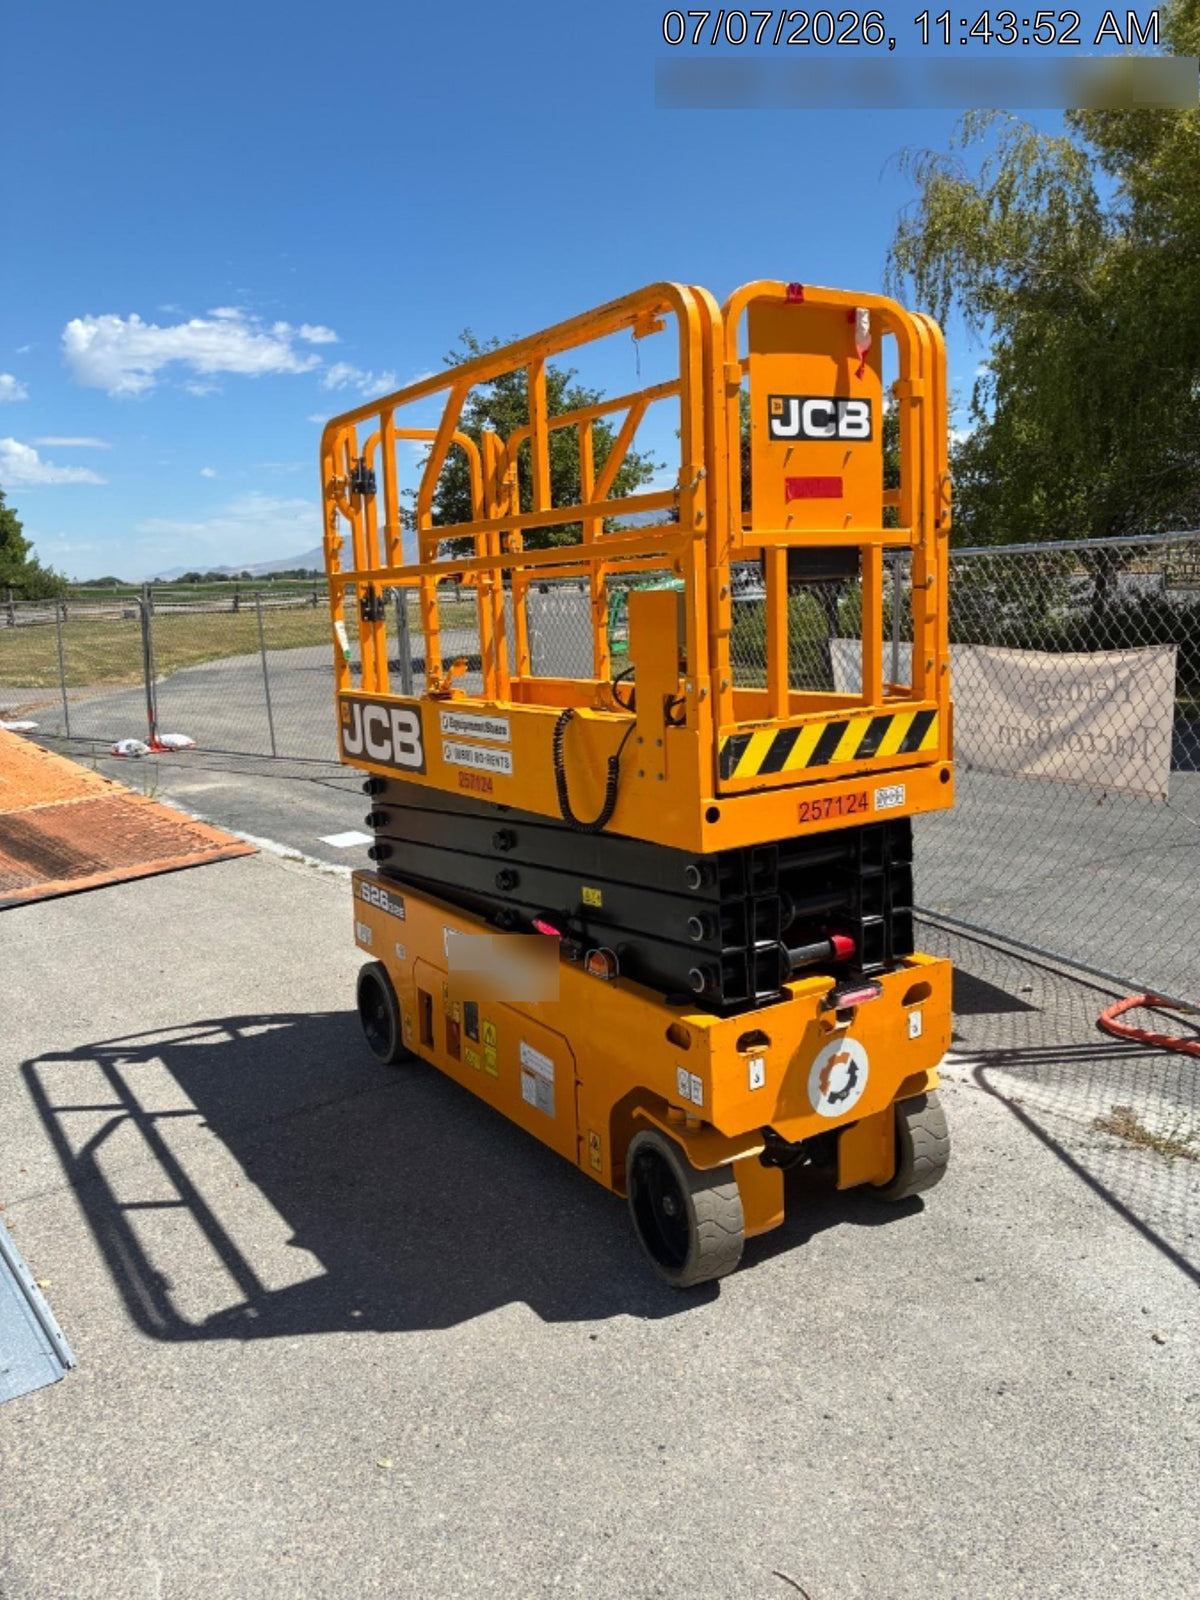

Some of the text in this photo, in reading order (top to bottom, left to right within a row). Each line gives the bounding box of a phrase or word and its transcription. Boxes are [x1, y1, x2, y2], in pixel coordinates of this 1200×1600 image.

[771, 399, 870, 438] JCB
[342, 703, 424, 768] JCB
[799, 790, 869, 824] 257124
